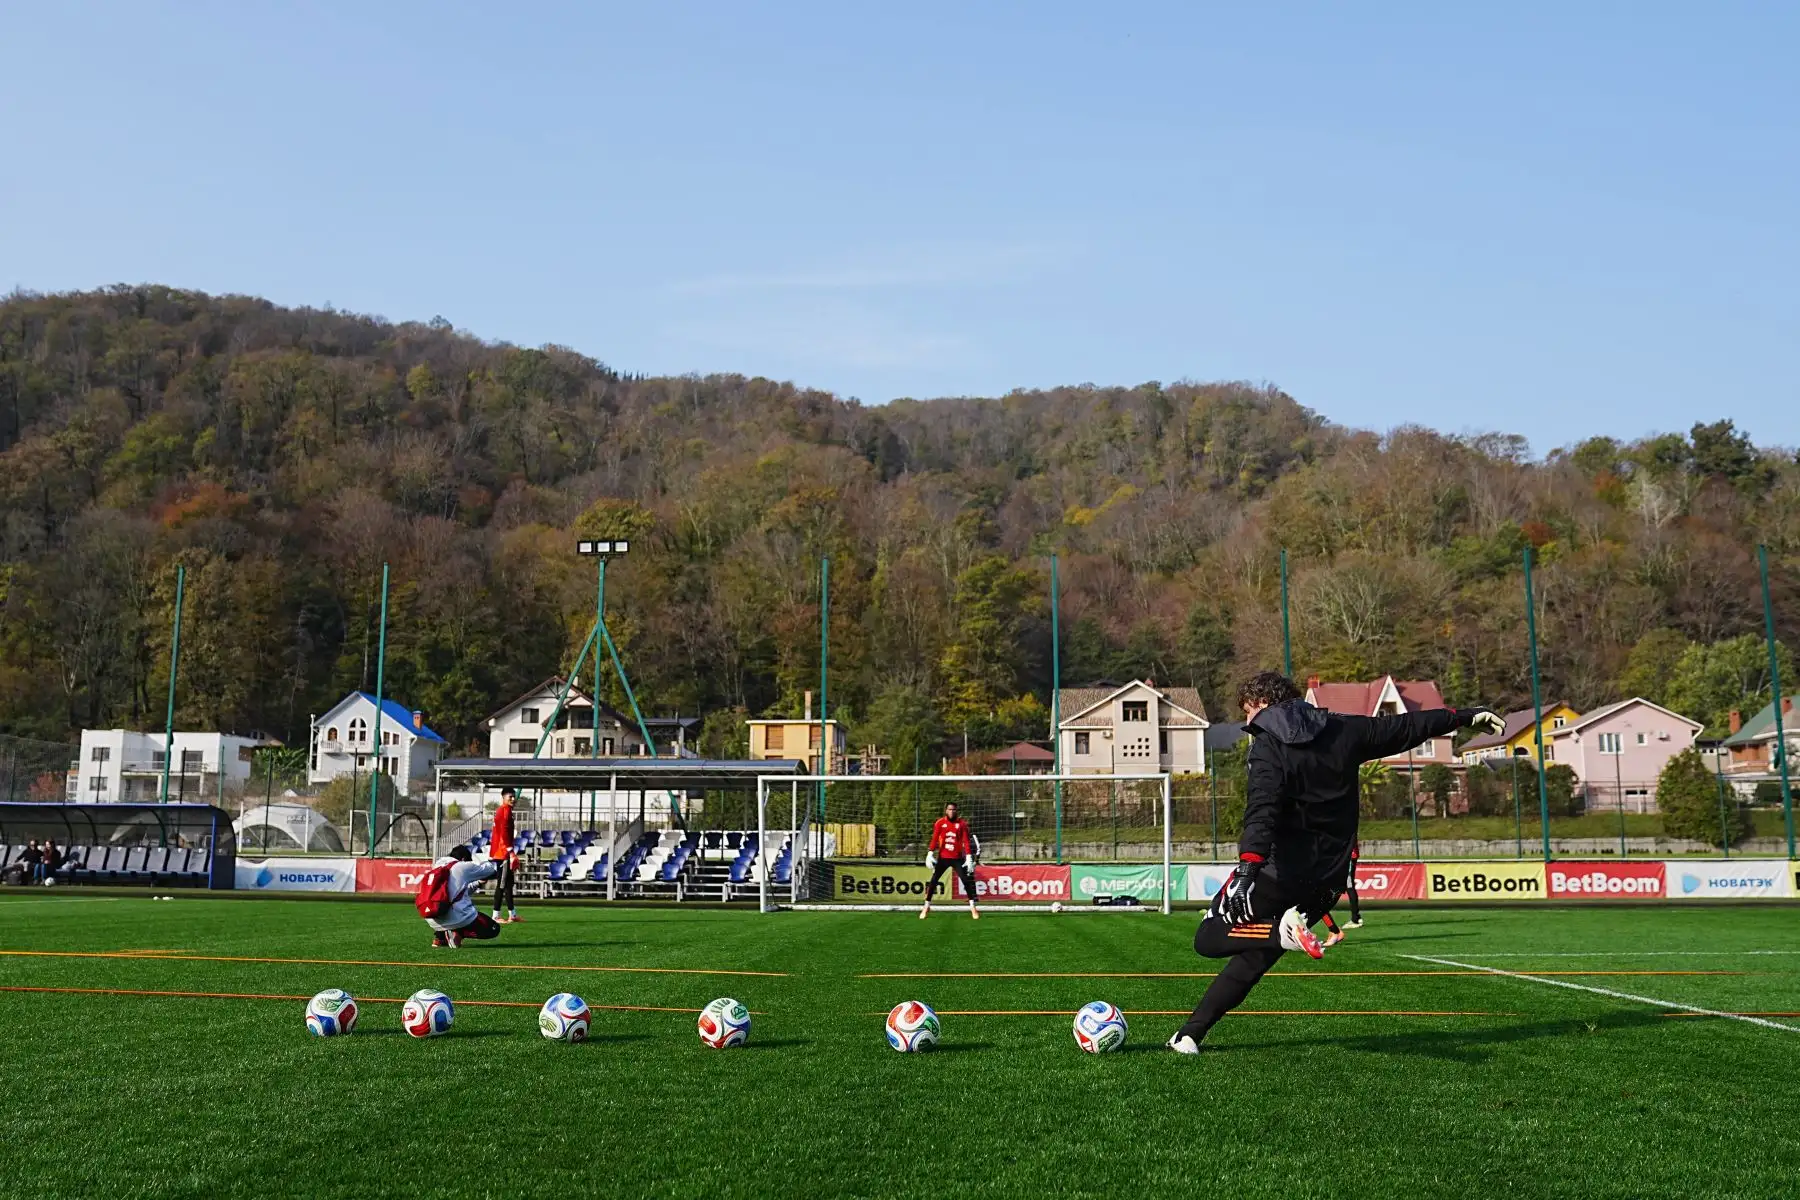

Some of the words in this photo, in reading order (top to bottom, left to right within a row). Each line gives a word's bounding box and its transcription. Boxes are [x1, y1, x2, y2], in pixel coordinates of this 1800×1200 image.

[279, 873, 335, 883] НОВАТЭК
[1432, 873, 1539, 893] BetBoom
[1551, 872, 1660, 893] BetBoom
[1708, 878, 1774, 888] НОВАТЭК
